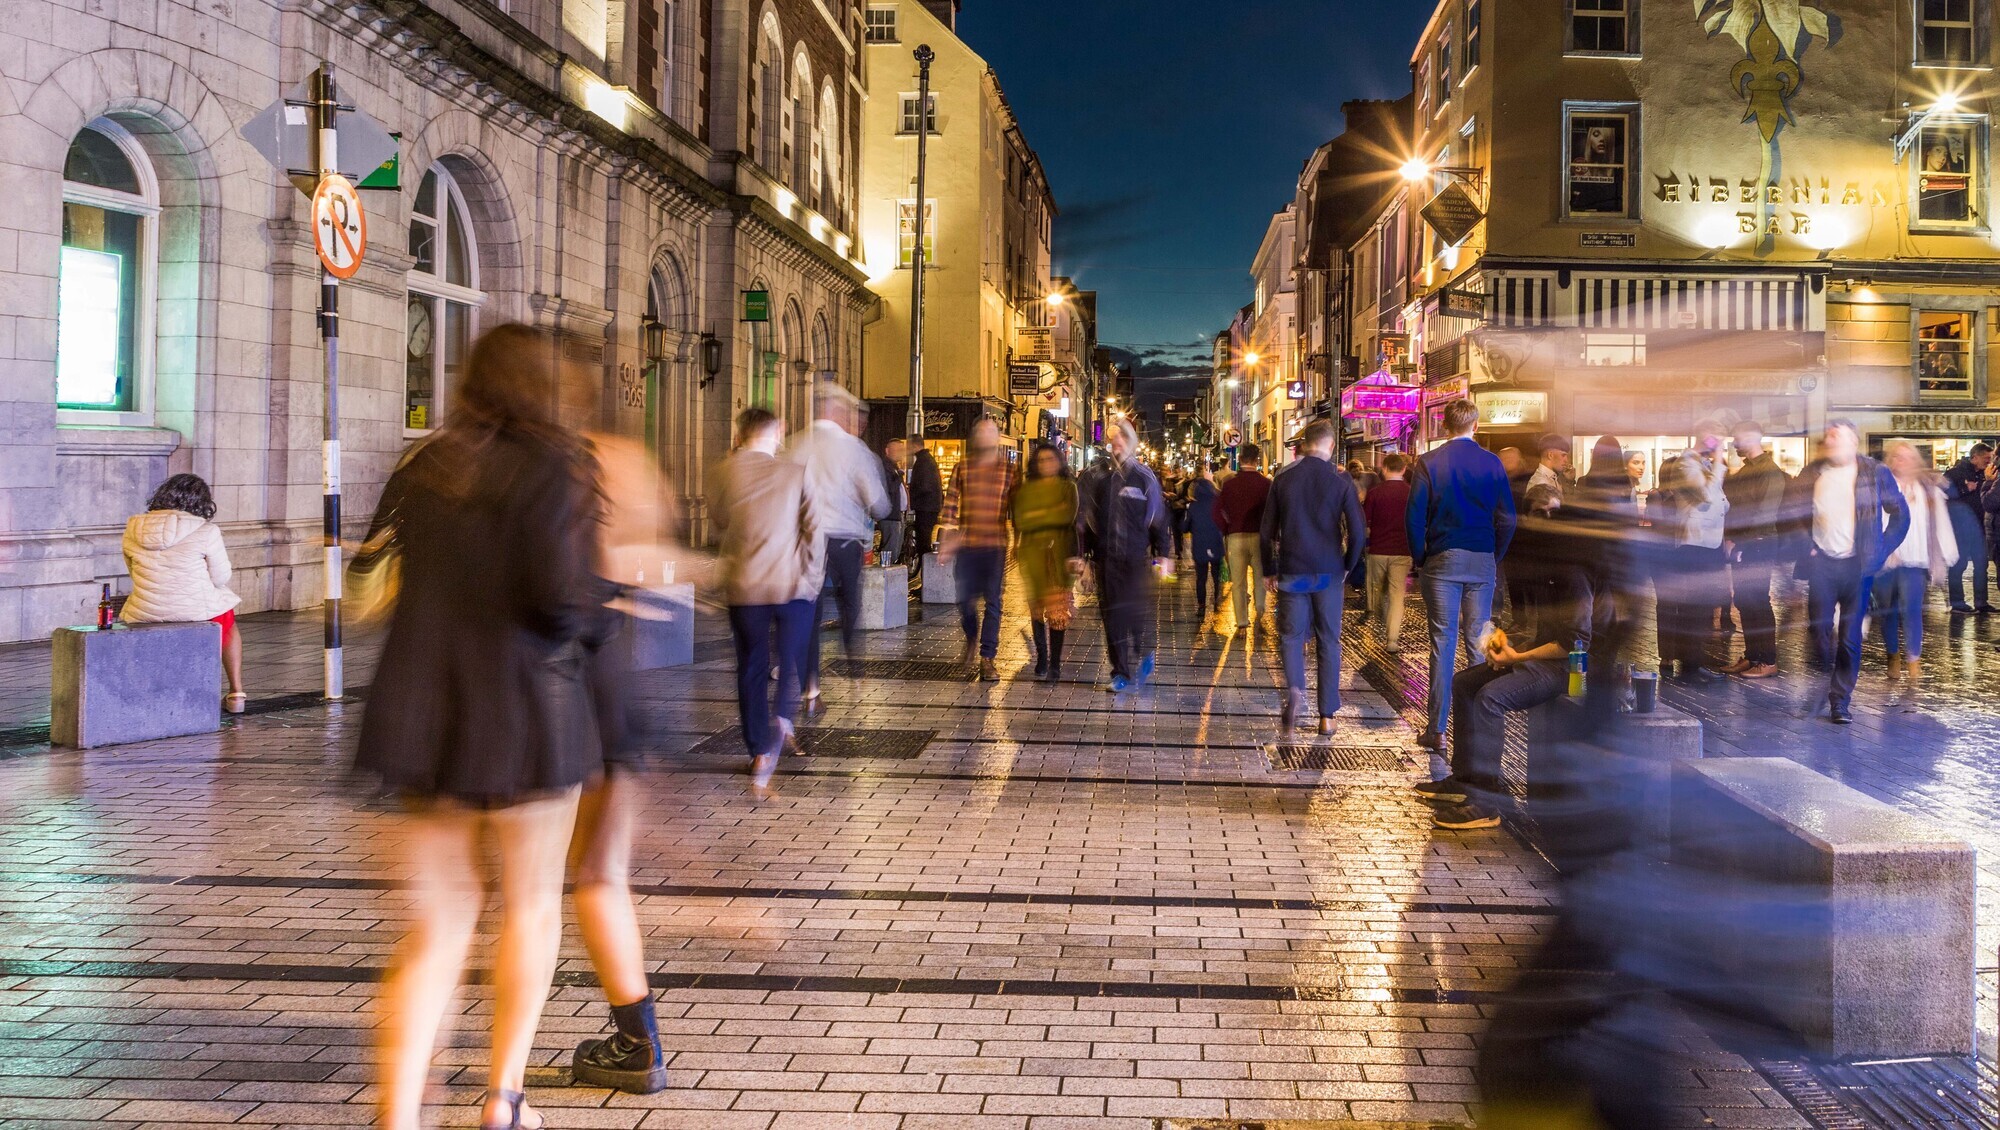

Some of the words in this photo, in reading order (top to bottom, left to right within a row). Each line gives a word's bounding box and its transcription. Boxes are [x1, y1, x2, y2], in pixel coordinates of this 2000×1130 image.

[1662, 183, 1887, 207] HIBERNIAN
[1738, 215, 1811, 235] BAR
[623, 363, 636, 382] an
[1801, 376, 1817, 388] life
[1500, 399, 1543, 407] pharmacy
